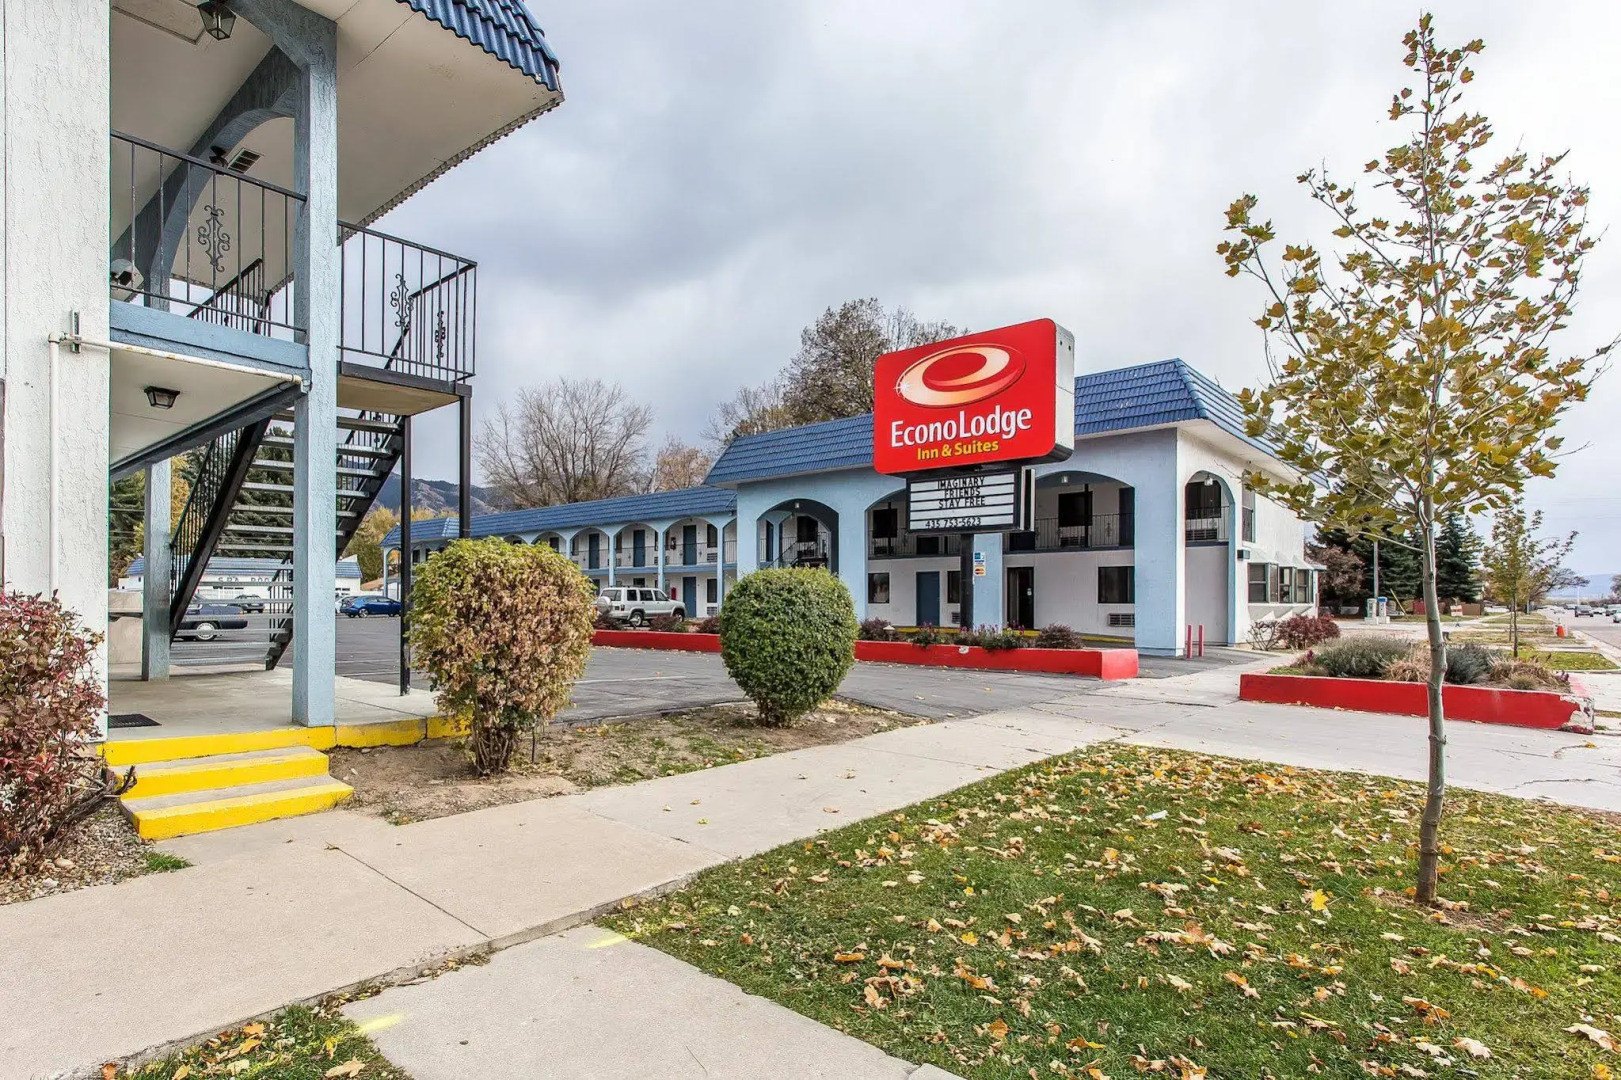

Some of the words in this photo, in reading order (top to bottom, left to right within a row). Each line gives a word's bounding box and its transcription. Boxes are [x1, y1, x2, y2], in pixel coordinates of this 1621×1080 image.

[891, 404, 1032, 447] EconoLodge
[917, 447, 939, 460] Inn
[941, 444, 952, 457] &
[954, 440, 999, 456] Suites
[937, 476, 985, 490] IMAGINARY
[944, 487, 981, 499] FRIENDS
[938, 498, 960, 509] STAY
[964, 496, 985, 507] FREE
[925, 520, 941, 528] 435
[944, 517, 981, 528] 753-5623
